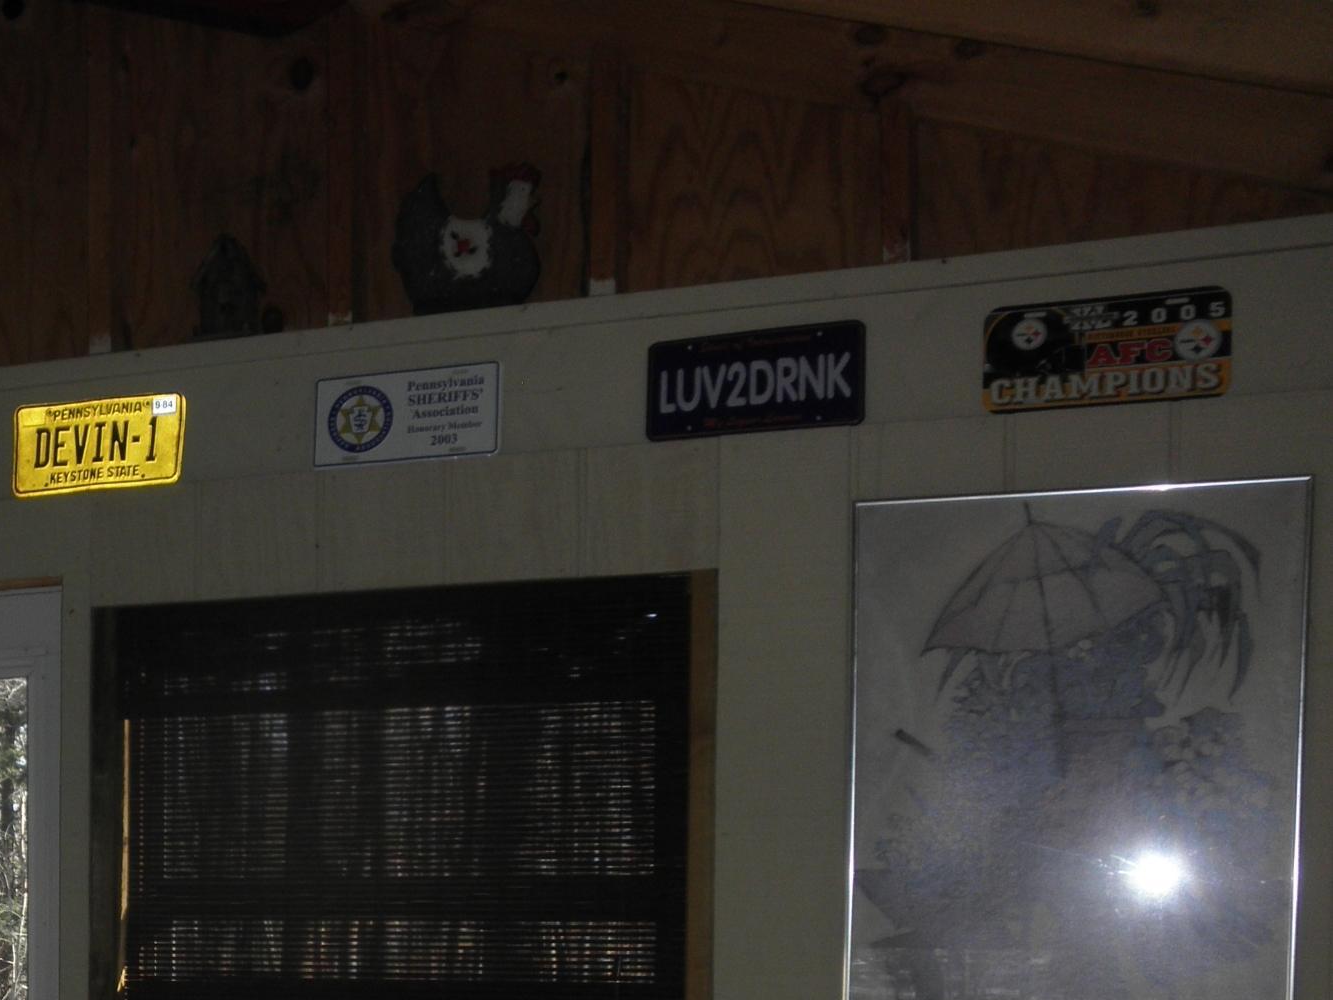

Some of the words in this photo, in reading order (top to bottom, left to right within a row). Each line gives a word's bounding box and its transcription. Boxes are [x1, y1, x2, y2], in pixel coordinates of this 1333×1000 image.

[1086, 337, 1174, 368] AFC
[407, 374, 485, 393] Pennsylvania
[658, 351, 853, 414] LUV2DRNK
[990, 362, 1219, 405] CHAMPIONS
[53, 400, 143, 422] PENNSYLVANIA
[411, 404, 479, 420] Association
[34, 416, 158, 469] DEVIN-1
[429, 433, 458, 446] 2003
[49, 467, 104, 484] KEYSTONE
[106, 464, 140, 478] STATE
